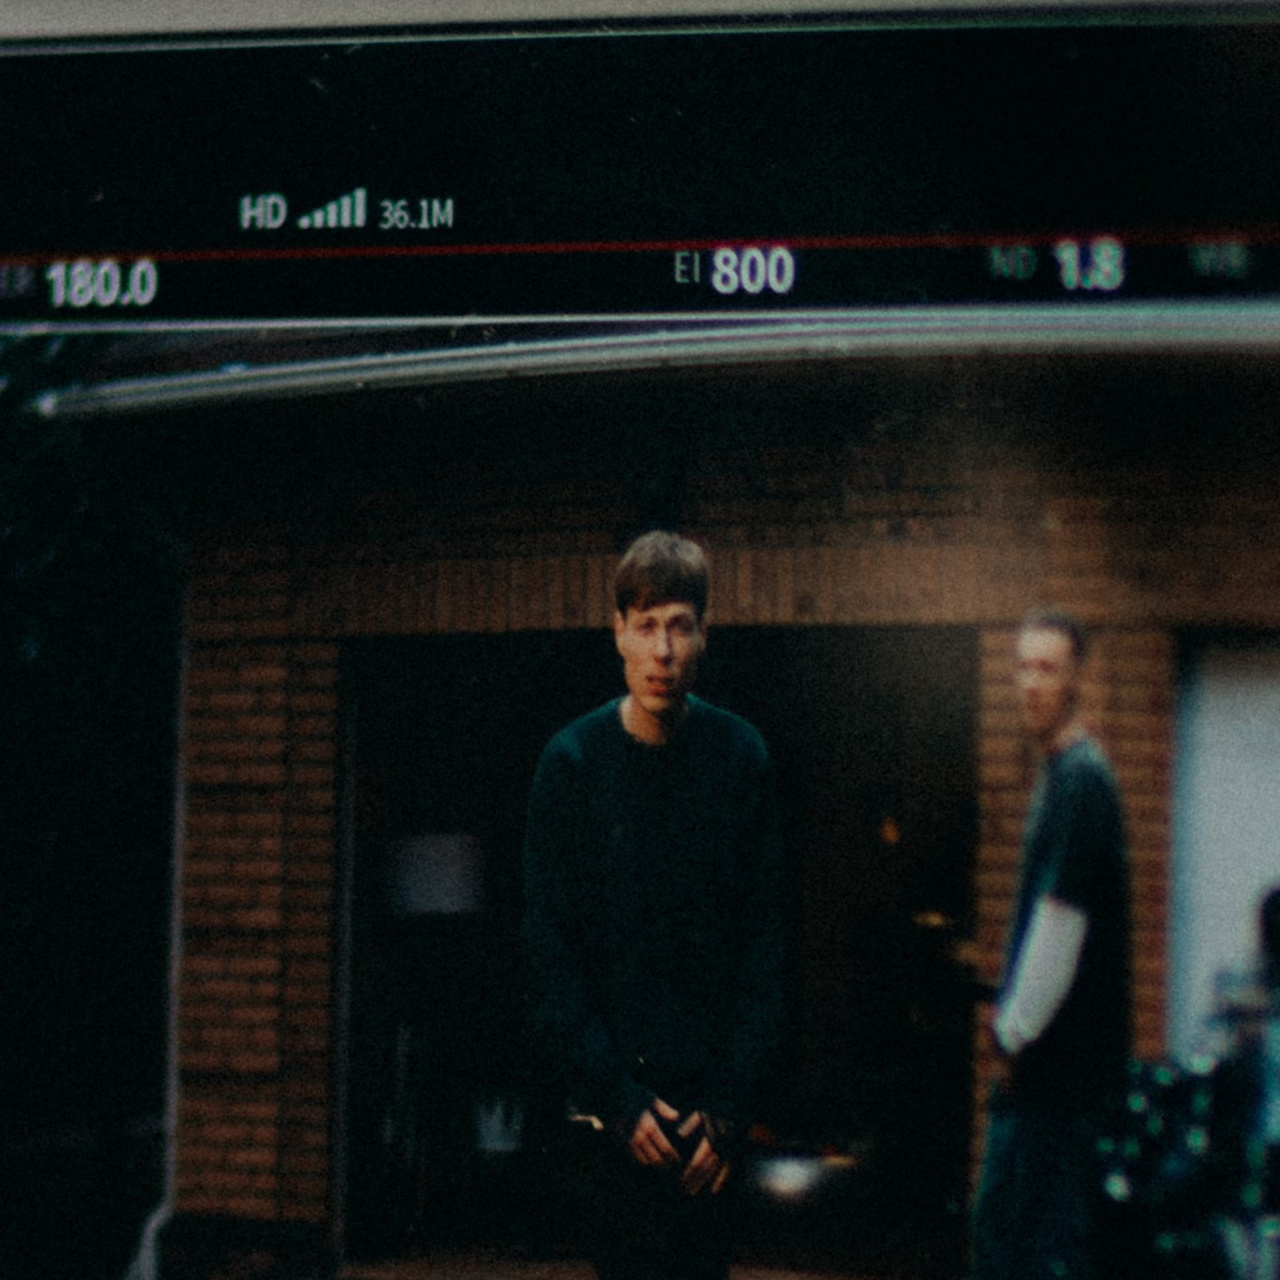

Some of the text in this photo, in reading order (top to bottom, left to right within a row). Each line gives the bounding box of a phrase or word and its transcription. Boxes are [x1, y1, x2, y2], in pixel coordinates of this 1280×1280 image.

[240, 195, 454, 229] HD 36.1M
[45, 258, 158, 307] 180.0
[674, 247, 795, 293] EI 800
